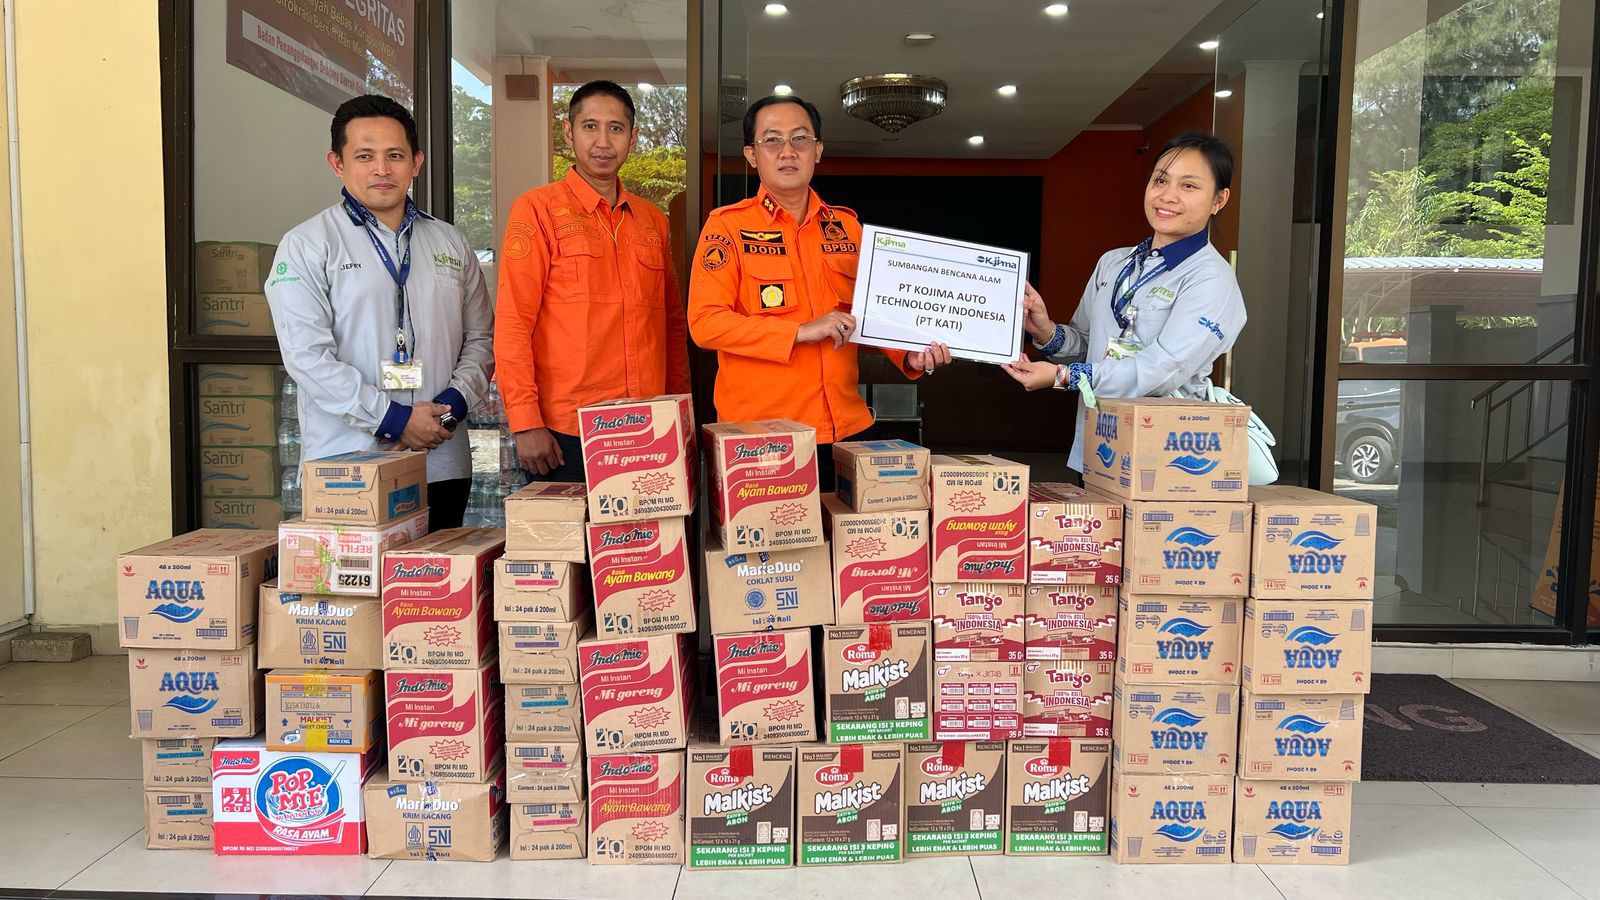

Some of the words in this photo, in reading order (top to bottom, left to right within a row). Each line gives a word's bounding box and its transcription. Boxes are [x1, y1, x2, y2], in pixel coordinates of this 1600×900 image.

[212, 249, 237, 258] Santri
[750, 245, 781, 254] DODI
[823, 244, 855, 252] BPBD
[888, 260, 939, 274] SUMBANGAN
[941, 268, 977, 280] BENCANA
[979, 275, 1001, 284] ALAM
[899, 283, 912, 293] PT
[914, 286, 954, 300] KOJIMA
[957, 293, 986, 305] AUTO
[203, 297, 244, 311] Santri
[876, 295, 947, 312] TECHNOLOGY
[949, 306, 1006, 322] INDONESIA
[916, 315, 933, 326] (PT
[935, 318, 962, 332] KATI)
[204, 401, 245, 415] Santri
[1095, 413, 1118, 443] AQUA
[1164, 431, 1222, 455] AQUA
[204, 451, 244, 465] Santri
[598, 454, 619, 466] Mi
[620, 452, 667, 466] goreng
[737, 487, 765, 501] Ayam
[767, 483, 808, 495] Bawang
[214, 501, 255, 514] Santri
[946, 520, 987, 532] Bawang
[989, 520, 1017, 532] Ayam
[1055, 515, 1102, 534] Tango
[1054, 543, 1100, 553] INDONESIA
[1163, 547, 1221, 570] AQUA
[1288, 551, 1347, 574] AQUA
[603, 574, 632, 587] Ayam
[634, 569, 675, 581] Bawang
[851, 566, 897, 578] goreng
[897, 567, 918, 578] Mi
[746, 577, 773, 585] COKLAT
[146, 580, 205, 603] AQUA
[776, 591, 798, 606] SNI
[957, 593, 1002, 611] Tango
[1048, 593, 1094, 611] Tango
[392, 607, 419, 618] Ayam
[421, 607, 462, 618] Bawang
[957, 621, 1001, 630] INDONESIA
[1048, 620, 1093, 630] INDONESIA
[324, 636, 346, 649] SNI
[1156, 637, 1214, 660] AQUA
[848, 650, 876, 659] Roma
[1284, 645, 1342, 668] AQUA
[842, 658, 909, 692] Malkist
[1046, 670, 1091, 688] Tango
[159, 672, 219, 694] AQUA
[731, 682, 752, 693] Mi
[753, 680, 798, 694] goreng
[595, 689, 615, 700] Mi
[617, 687, 663, 701] goreng
[1046, 697, 1089, 707] INDONESIA
[399, 717, 420, 728] Mi
[421, 719, 464, 731] goreng
[836, 722, 877, 730] SEKARANG
[1150, 727, 1208, 750] AQUA
[1275, 734, 1332, 757] AQUA
[1030, 764, 1058, 773] Roma
[271, 768, 312, 795] POP
[710, 773, 739, 783] Roma
[820, 773, 849, 781] Roma
[920, 771, 986, 803] Malkist
[1024, 773, 1089, 803] Malkist
[278, 785, 324, 812] MIE
[704, 782, 772, 815] Malkist
[815, 781, 881, 814] Malkist
[600, 803, 628, 815] Ayam
[630, 803, 670, 813] Bawang
[1150, 801, 1207, 823] AQUA
[1266, 801, 1322, 823] AQUA
[726, 817, 748, 826] ABON
[273, 825, 300, 839] RASA
[302, 829, 330, 839] AYAM
[429, 829, 451, 844] SNI
